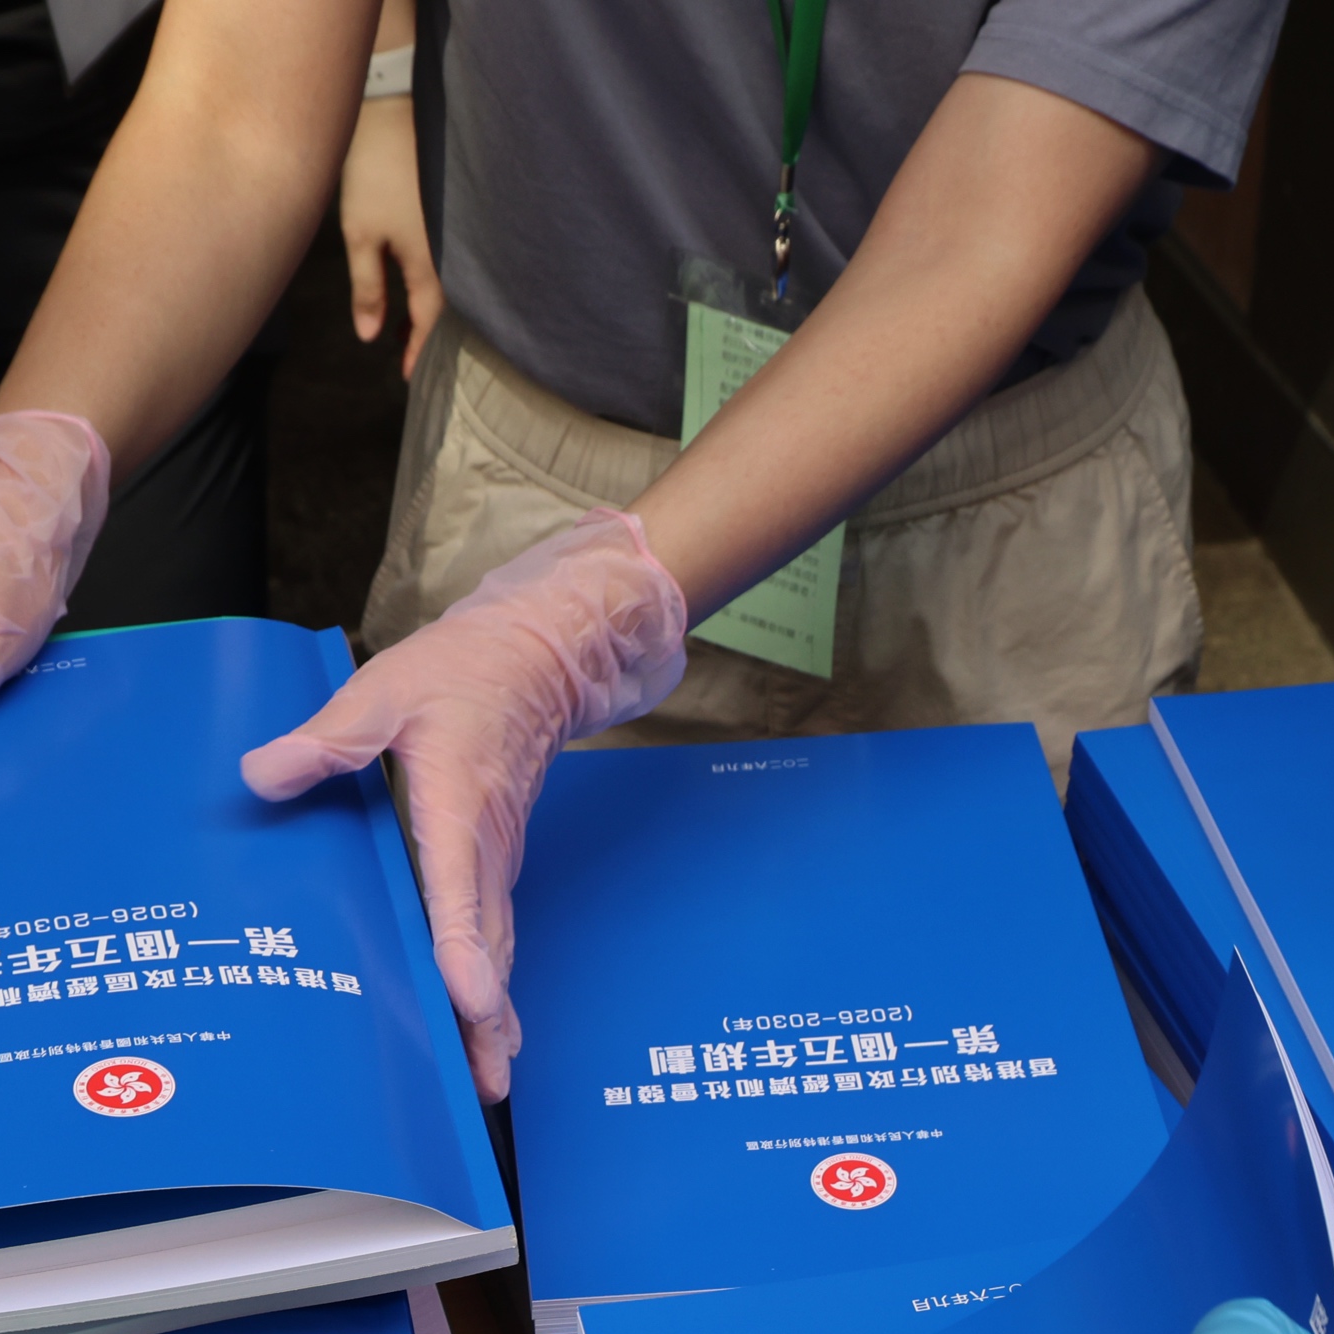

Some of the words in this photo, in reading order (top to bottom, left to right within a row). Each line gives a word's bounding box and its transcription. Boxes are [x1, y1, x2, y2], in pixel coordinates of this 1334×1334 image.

[648, 1024, 1001, 1077] 第一個五年規劃
[602, 1056, 1058, 1107] 香港特別行政區經濟和社會發展
[745, 1128, 944, 1152] 中華人民共和國香港特別行政區
